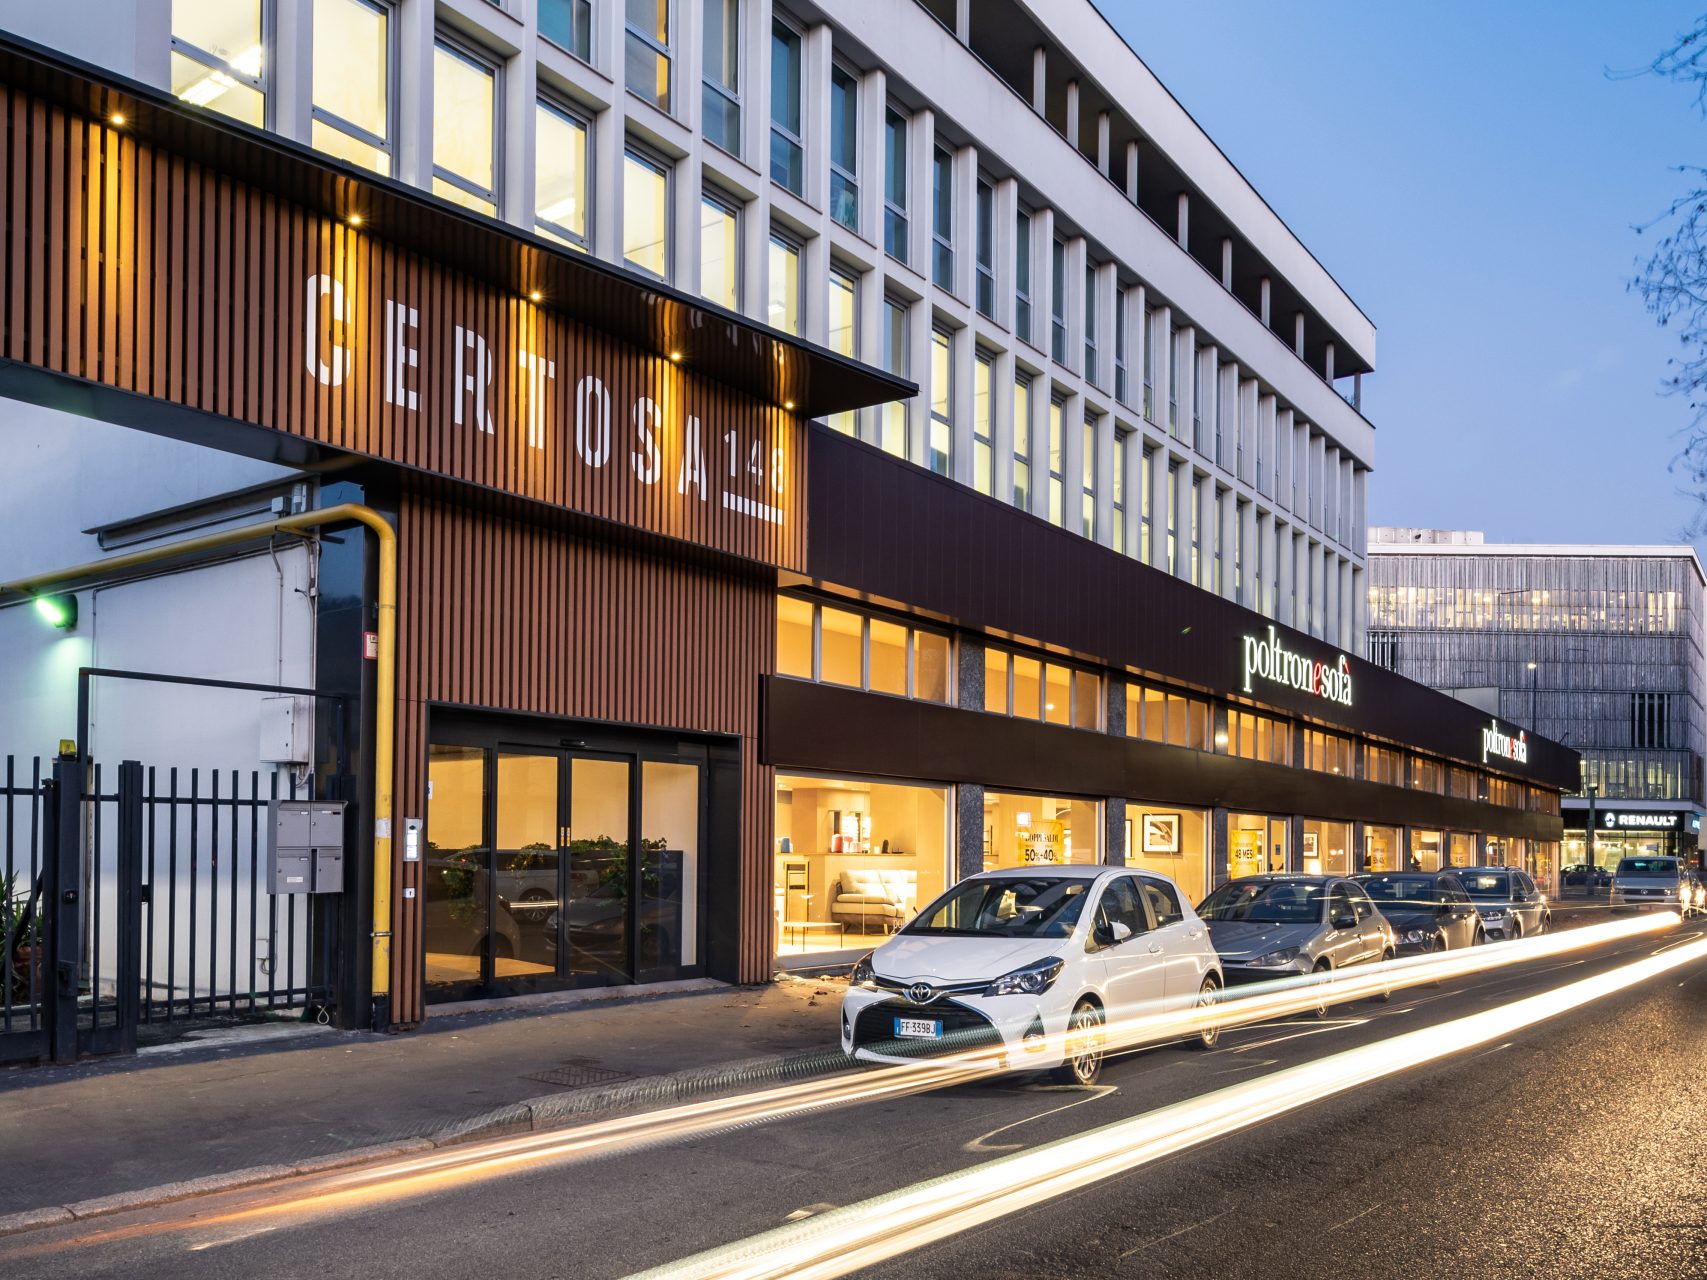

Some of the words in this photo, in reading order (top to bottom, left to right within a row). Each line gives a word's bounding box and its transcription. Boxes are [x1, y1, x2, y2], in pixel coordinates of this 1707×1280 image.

[305, 273, 708, 501] CERTOSA
[723, 429, 785, 494] 148
[1243, 624, 1352, 706] poltronesofà
[1482, 719, 1527, 764] poltronesofà
[1618, 814, 1677, 826] RENAULT
